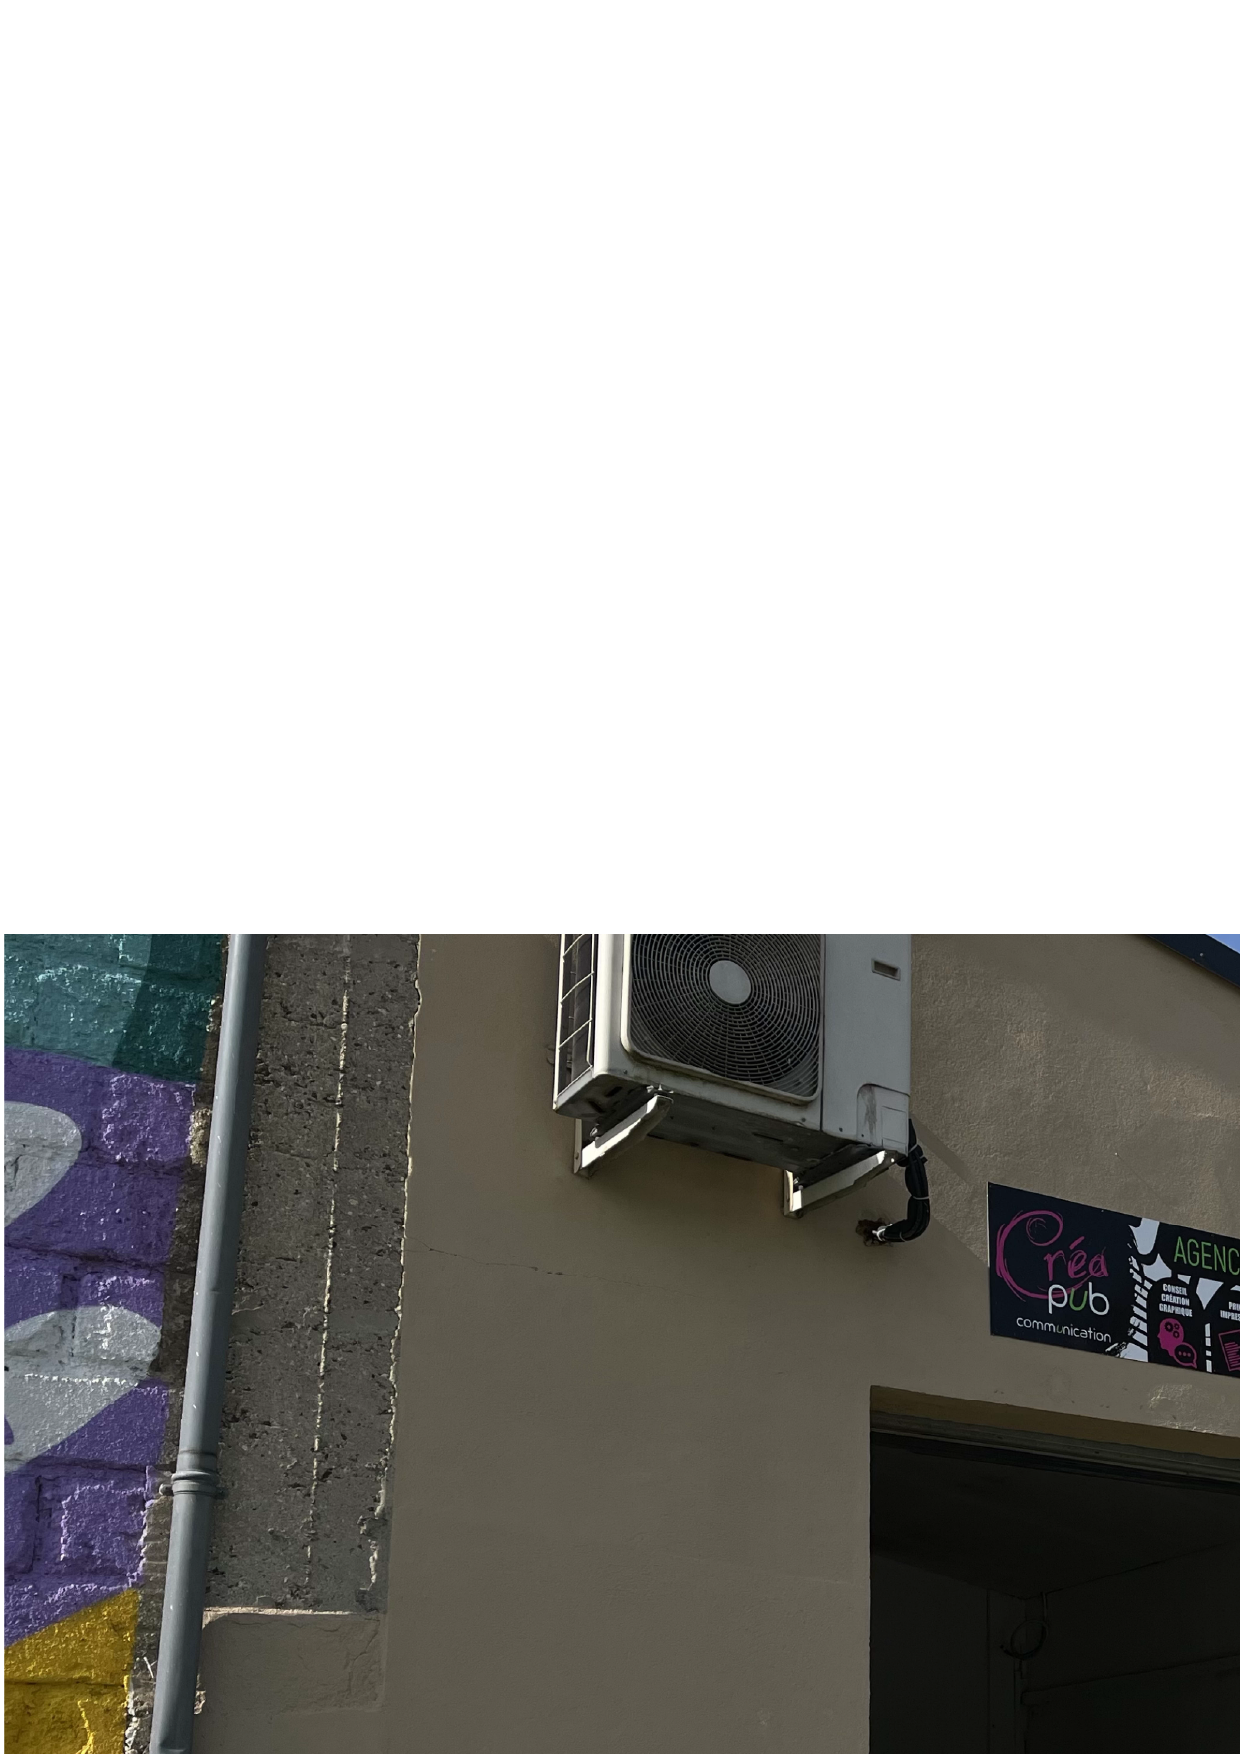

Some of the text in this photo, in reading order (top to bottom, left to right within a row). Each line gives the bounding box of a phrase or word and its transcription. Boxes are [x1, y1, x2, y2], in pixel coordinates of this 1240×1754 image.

[996, 1209, 1109, 1301] Créa
[1048, 1282, 1110, 1315] pub
[1161, 1293, 1190, 1306] CRÉATION
[1162, 1283, 1188, 1296] CONSEIL
[1158, 1303, 1193, 1317] GRAPHIQUE
[1016, 1316, 1111, 1343] communication
